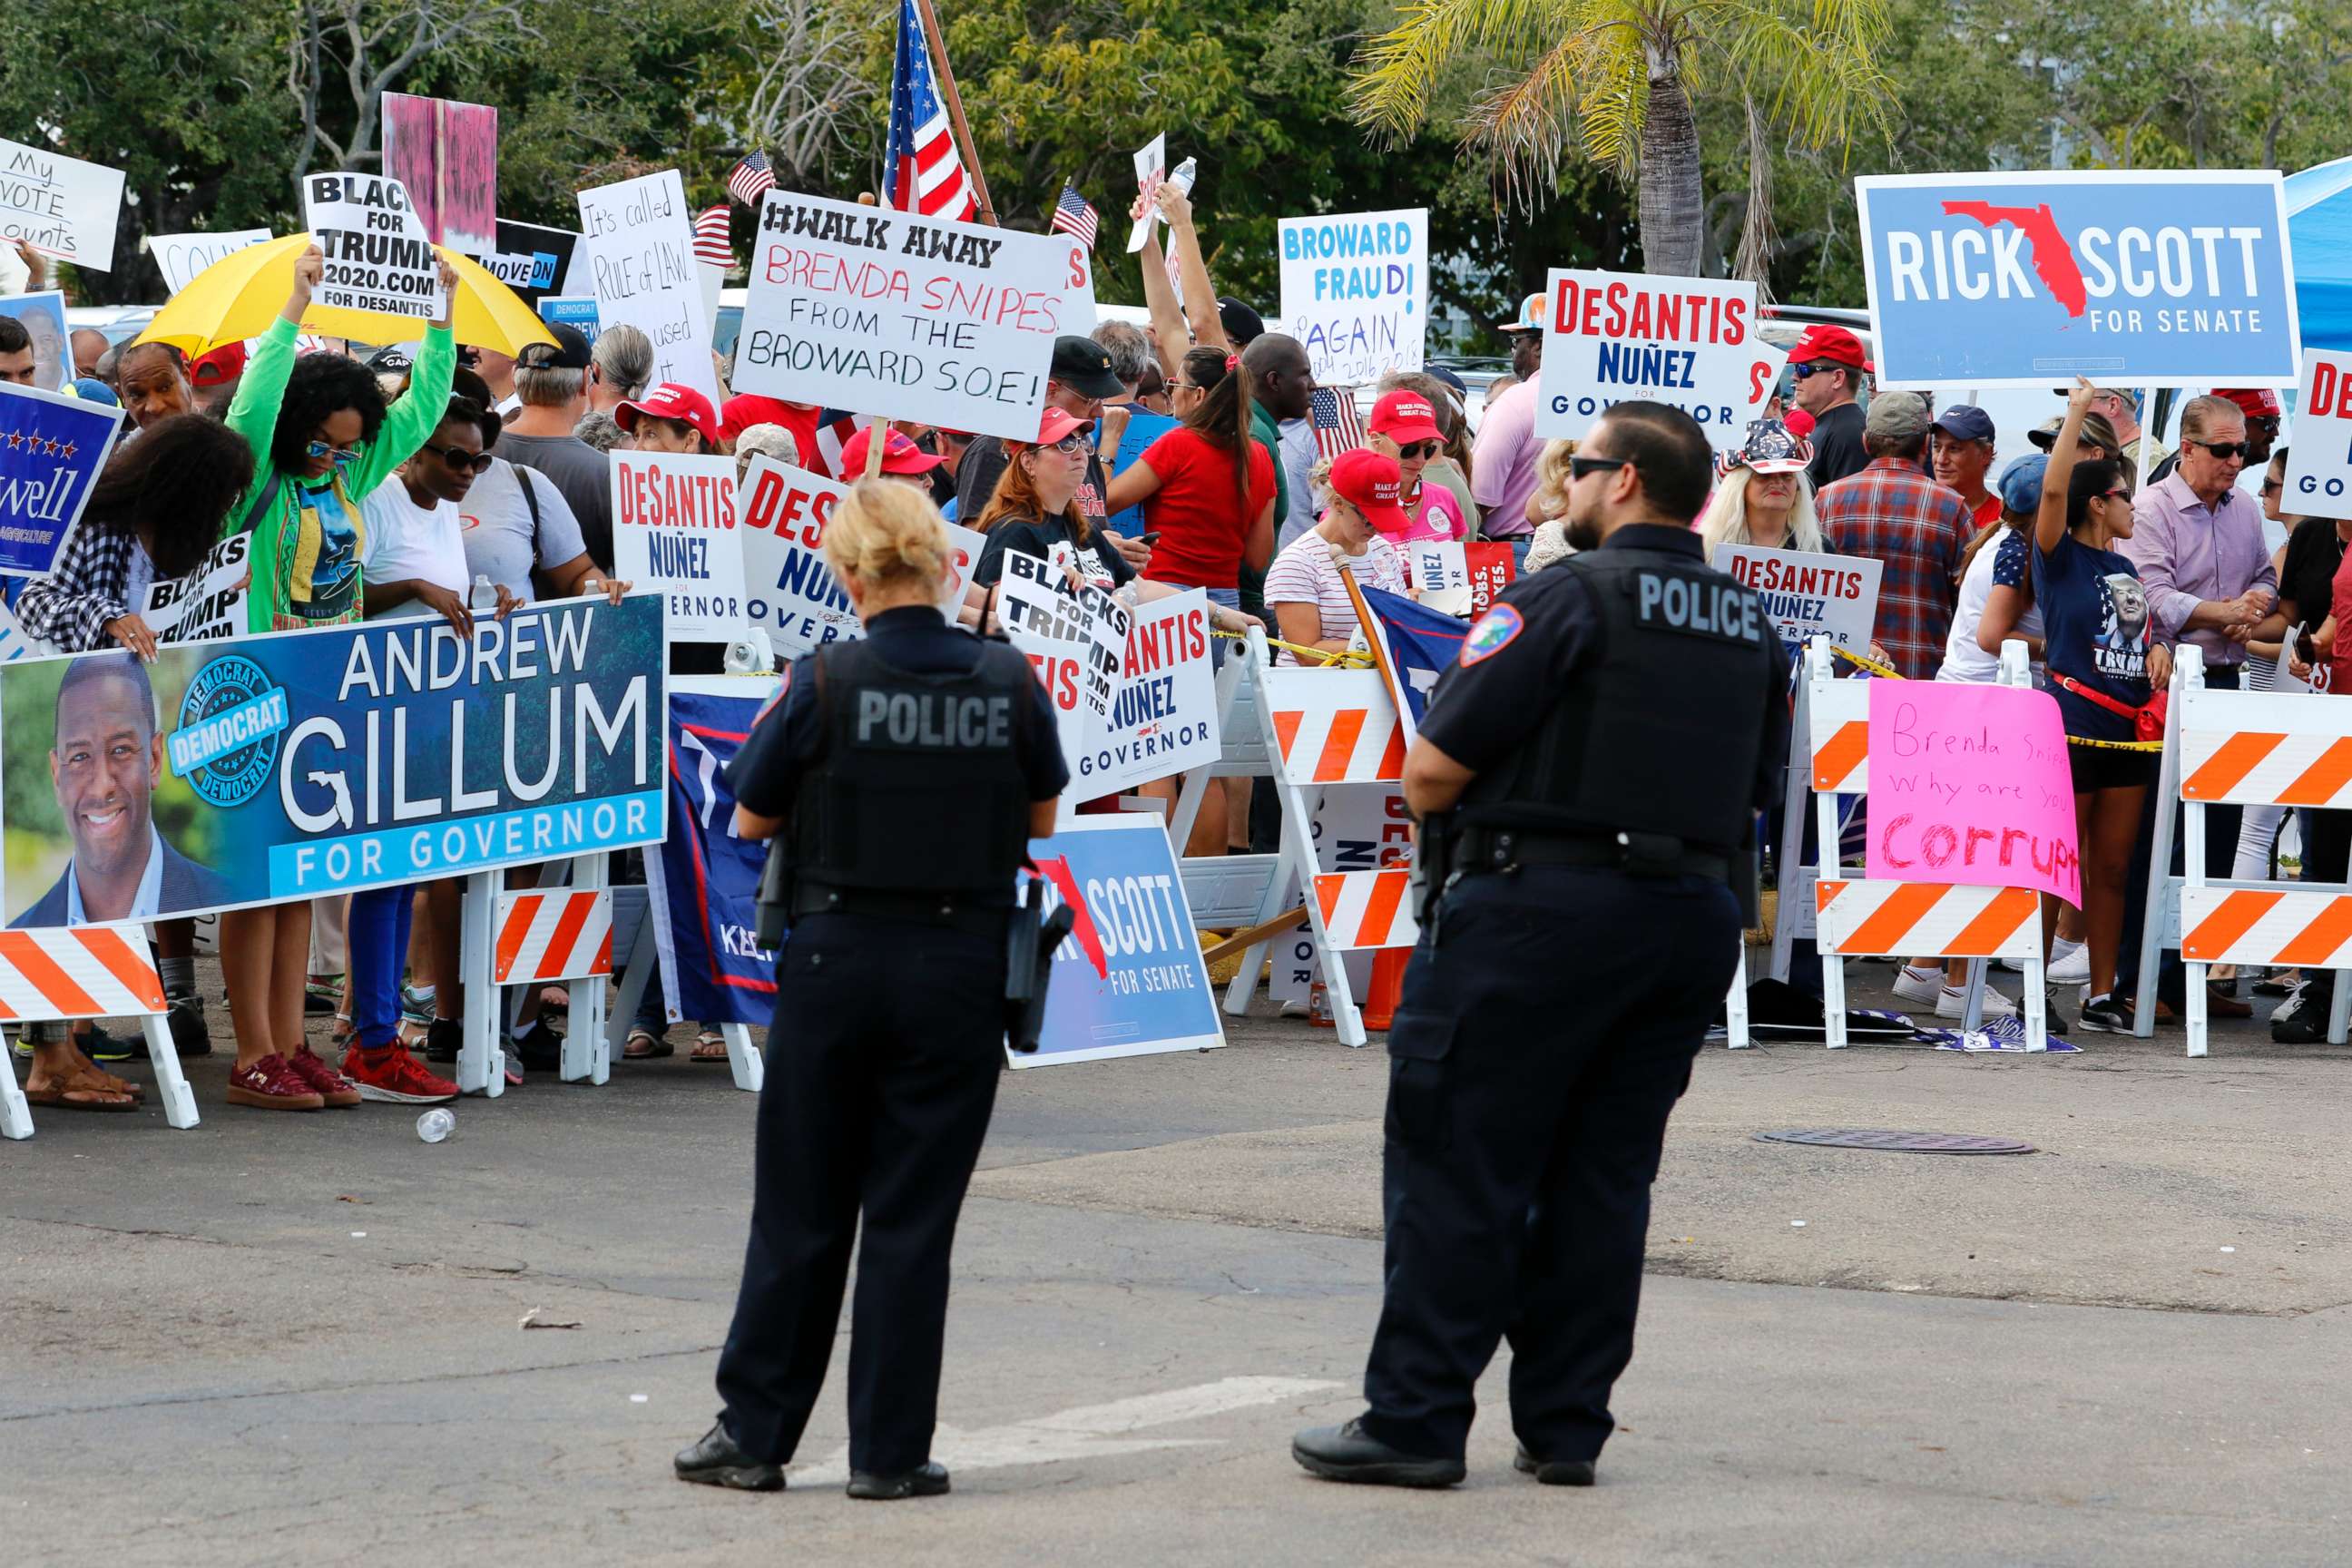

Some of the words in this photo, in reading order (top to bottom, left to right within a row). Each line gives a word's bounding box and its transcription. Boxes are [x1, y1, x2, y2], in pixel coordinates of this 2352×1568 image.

[9, 151, 53, 188] My
[0, 180, 64, 218] VOTE
[367, 211, 404, 233] FOR
[584, 204, 617, 239] It's
[626, 179, 671, 227] called
[5, 223, 76, 251] ounts
[763, 201, 892, 250] #WALK
[901, 224, 1003, 269] AWAY
[1283, 221, 1412, 261] BROWARD
[325, 264, 435, 297] 2020.COM
[594, 254, 636, 304] RULE
[639, 250, 652, 291] of
[766, 244, 909, 303] BRENDA
[1886, 228, 2036, 301] RICK
[2078, 225, 2262, 299] SCOTT
[324, 291, 353, 308] FOR
[358, 296, 434, 318] DESANTIS
[556, 304, 595, 314] DEMOCRAT
[1314, 262, 1414, 316] FRAUD!
[1554, 279, 1747, 347] DESANTIS
[653, 301, 691, 348] used
[790, 298, 879, 337] FROM
[901, 314, 982, 350] THE
[1305, 310, 1398, 358] AGAIN
[2091, 309, 2143, 332] FOR
[2158, 309, 2263, 334] SENATE
[748, 329, 924, 387] BROWARD
[1343, 358, 1377, 380] 2016
[1597, 341, 1697, 389] NUÑEZ
[1634, 389, 1655, 398] FOR
[619, 462, 736, 530] DESANTIS
[1374, 483, 1392, 491] MAKE
[648, 530, 710, 580] NUÑEZ
[1422, 553, 1446, 591] UÑEZ
[1731, 554, 1863, 600] DESANTIS
[182, 583, 205, 613] FOR
[671, 595, 739, 618] ERNOR
[1009, 554, 1129, 637] BLACKS
[1055, 599, 1094, 631] FOR
[1639, 573, 1760, 642] POLICE
[1759, 591, 1827, 622] NUÑEZ
[338, 606, 594, 701] ANDREW
[188, 662, 260, 715] DEMOCRAT
[173, 694, 283, 769] DEMOCRAT
[858, 690, 1010, 748] POLICE
[1893, 702, 1999, 757] Brenda
[201, 747, 272, 800] DEMOCRAT
[279, 674, 648, 833] GILLUM
[1080, 721, 1210, 776] GOVERNOR
[1977, 783, 2024, 799] are
[297, 838, 383, 887] FOR
[410, 799, 647, 869] GOVERNOR
[1882, 812, 2081, 892] Corrupt
[1087, 874, 1185, 957] SCOTT
[1110, 969, 1141, 996] FOR
[1143, 964, 1195, 994] SENATE
